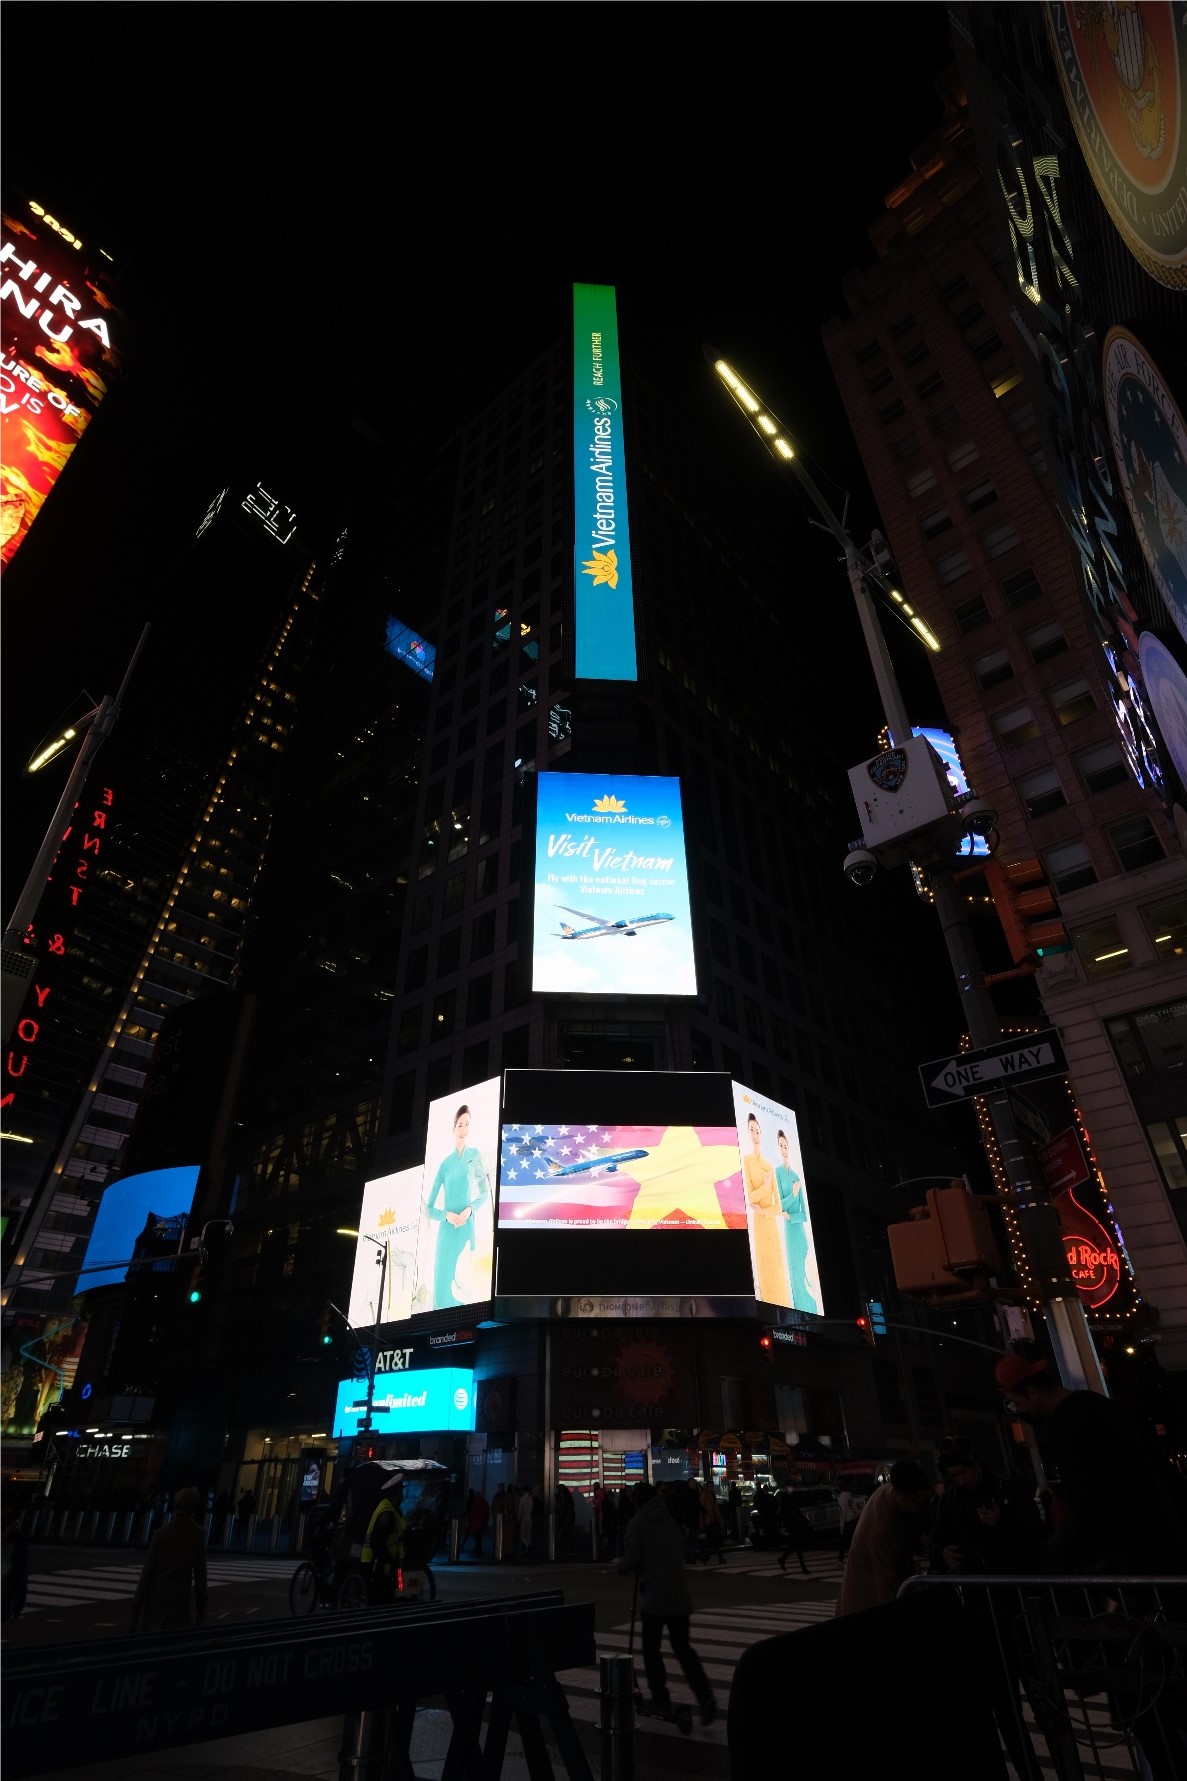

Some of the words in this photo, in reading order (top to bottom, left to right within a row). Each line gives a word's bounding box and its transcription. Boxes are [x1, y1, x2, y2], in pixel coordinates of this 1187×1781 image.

[591, 332, 603, 361] FURTHER
[592, 363, 604, 386] REACH
[20, 392, 45, 415] IS
[1114, 342, 1133, 372] AIR
[1134, 355, 1182, 438] FORCE
[47, 391, 82, 418] OF
[589, 417, 613, 475] Airlines
[591, 477, 616, 549] Vietnam
[565, 813, 613, 823] Vietnam
[613, 815, 655, 825] Airlines
[547, 833, 599, 858] Visit
[592, 847, 675, 873] Vietnam
[547, 873, 559, 883] Fly
[580, 875, 593, 884] the
[596, 875, 629, 885] national
[943, 1064, 983, 1089] ONE
[999, 1047, 1045, 1073] WAY
[1078, 1245, 1119, 1270] Rock
[1072, 1269, 1096, 1279] CAFE
[375, 1348, 414, 1372] AT&T
[76, 1444, 131, 1458] CHASE
[91, 1671, 160, 1715] LINE
[202, 1660, 237, 1697] DO
[246, 1651, 295, 1689] NOT
[303, 1640, 375, 1681] CROSS
[136, 1702, 231, 1741] NYPD
